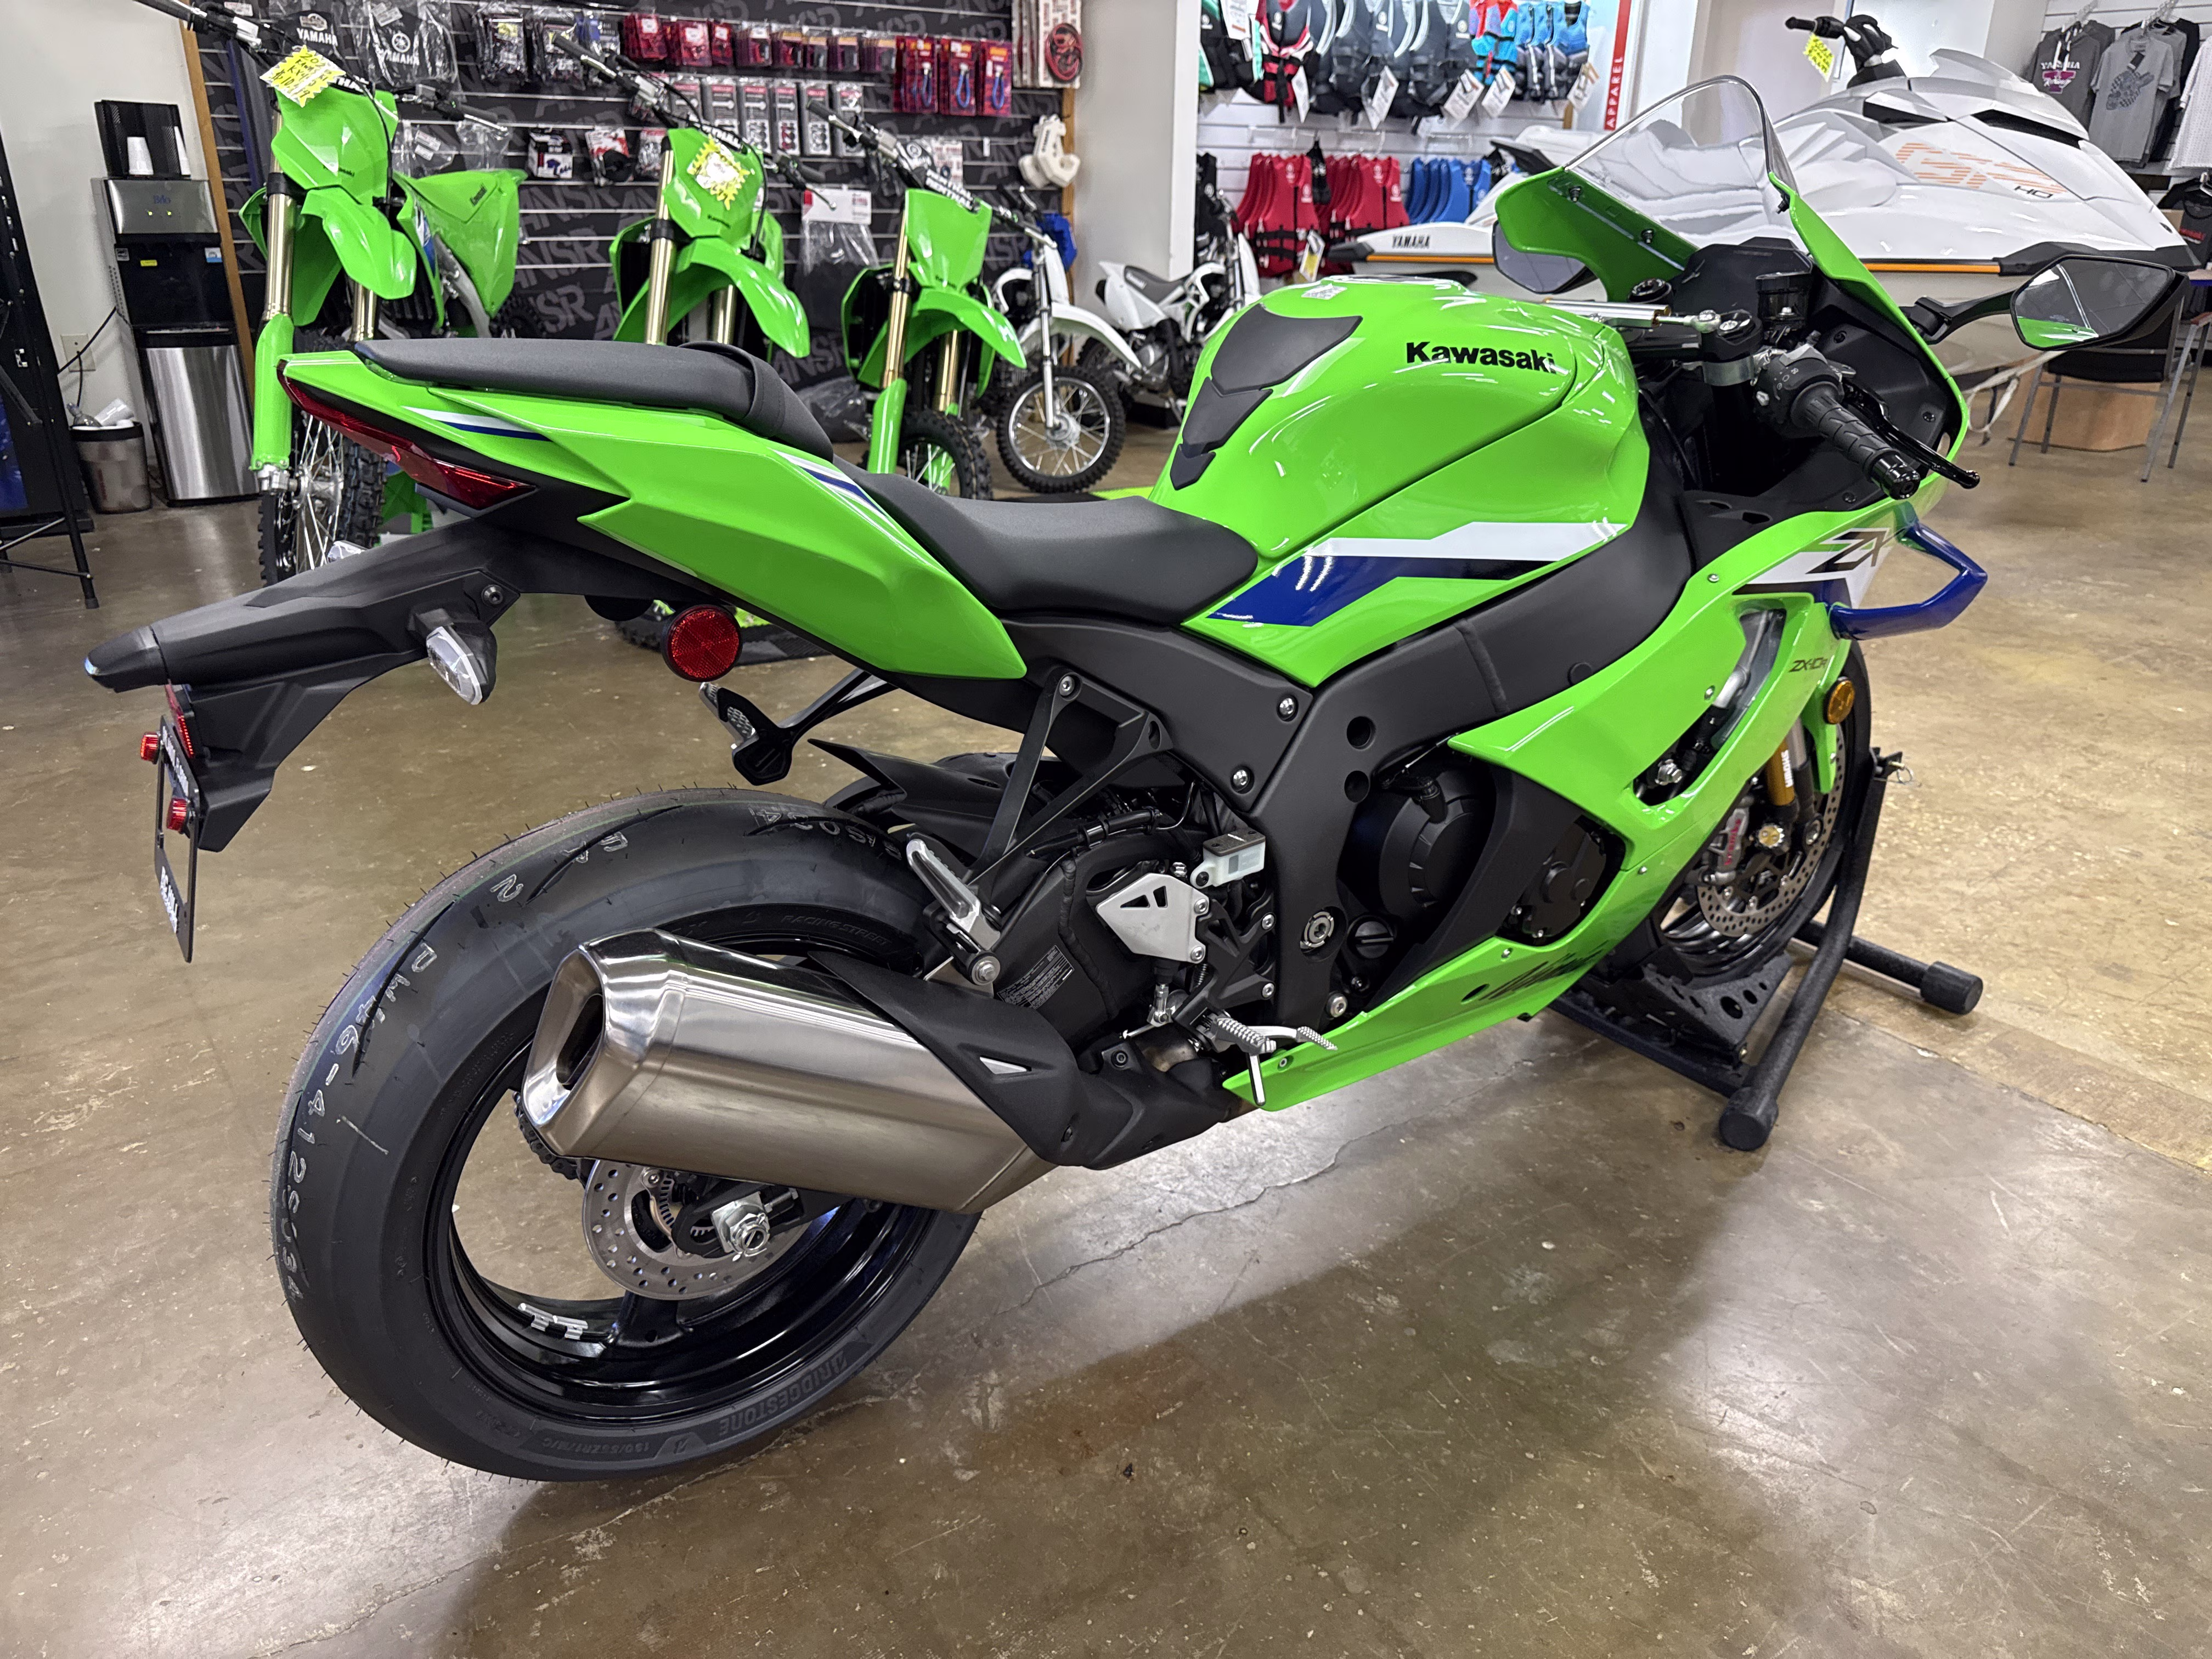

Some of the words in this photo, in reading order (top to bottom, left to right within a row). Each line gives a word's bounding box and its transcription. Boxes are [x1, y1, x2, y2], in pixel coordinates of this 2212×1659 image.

[296, 28, 338, 46] YAMAHA
[1605, 57, 1624, 128] APPAREL
[1392, 235, 1430, 249] YAMAHA
[1406, 341, 1557, 374] Kawasaki
[719, 1350, 848, 1436] BRIDGESTONE
